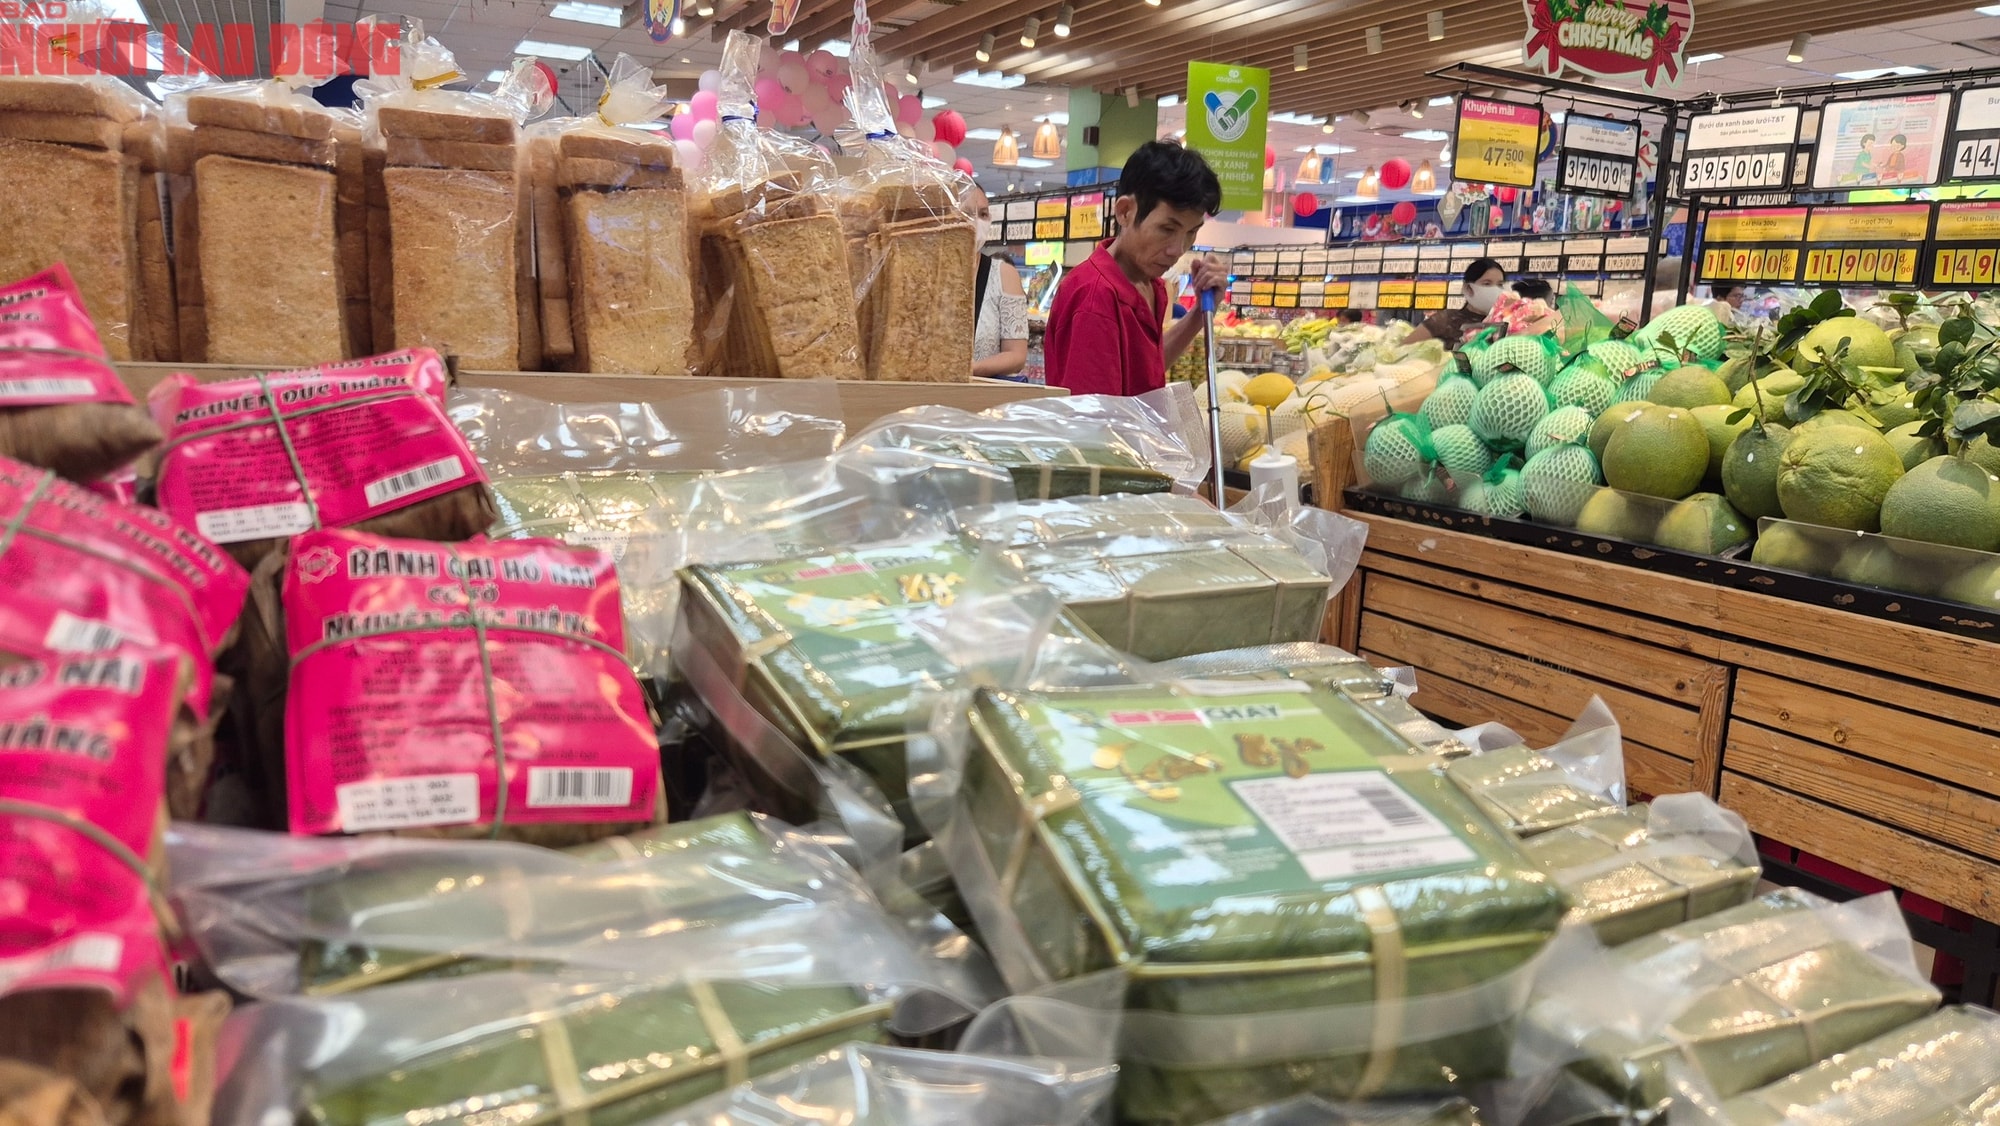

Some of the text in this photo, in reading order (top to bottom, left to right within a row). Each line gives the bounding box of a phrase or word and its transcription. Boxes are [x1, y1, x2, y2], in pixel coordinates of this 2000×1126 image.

[1557, 21, 1654, 60] CHRISTMAS
[1464, 99, 1515, 117] Khuyến mãi
[1223, 160, 1249, 170] XANH
[1689, 159, 1763, 182] 39.500
[1708, 253, 1779, 274] 11.900
[1812, 252, 1895, 275] 11.900
[1941, 254, 2000, 277] 14.9
[1203, 703, 1280, 721] CHAY
